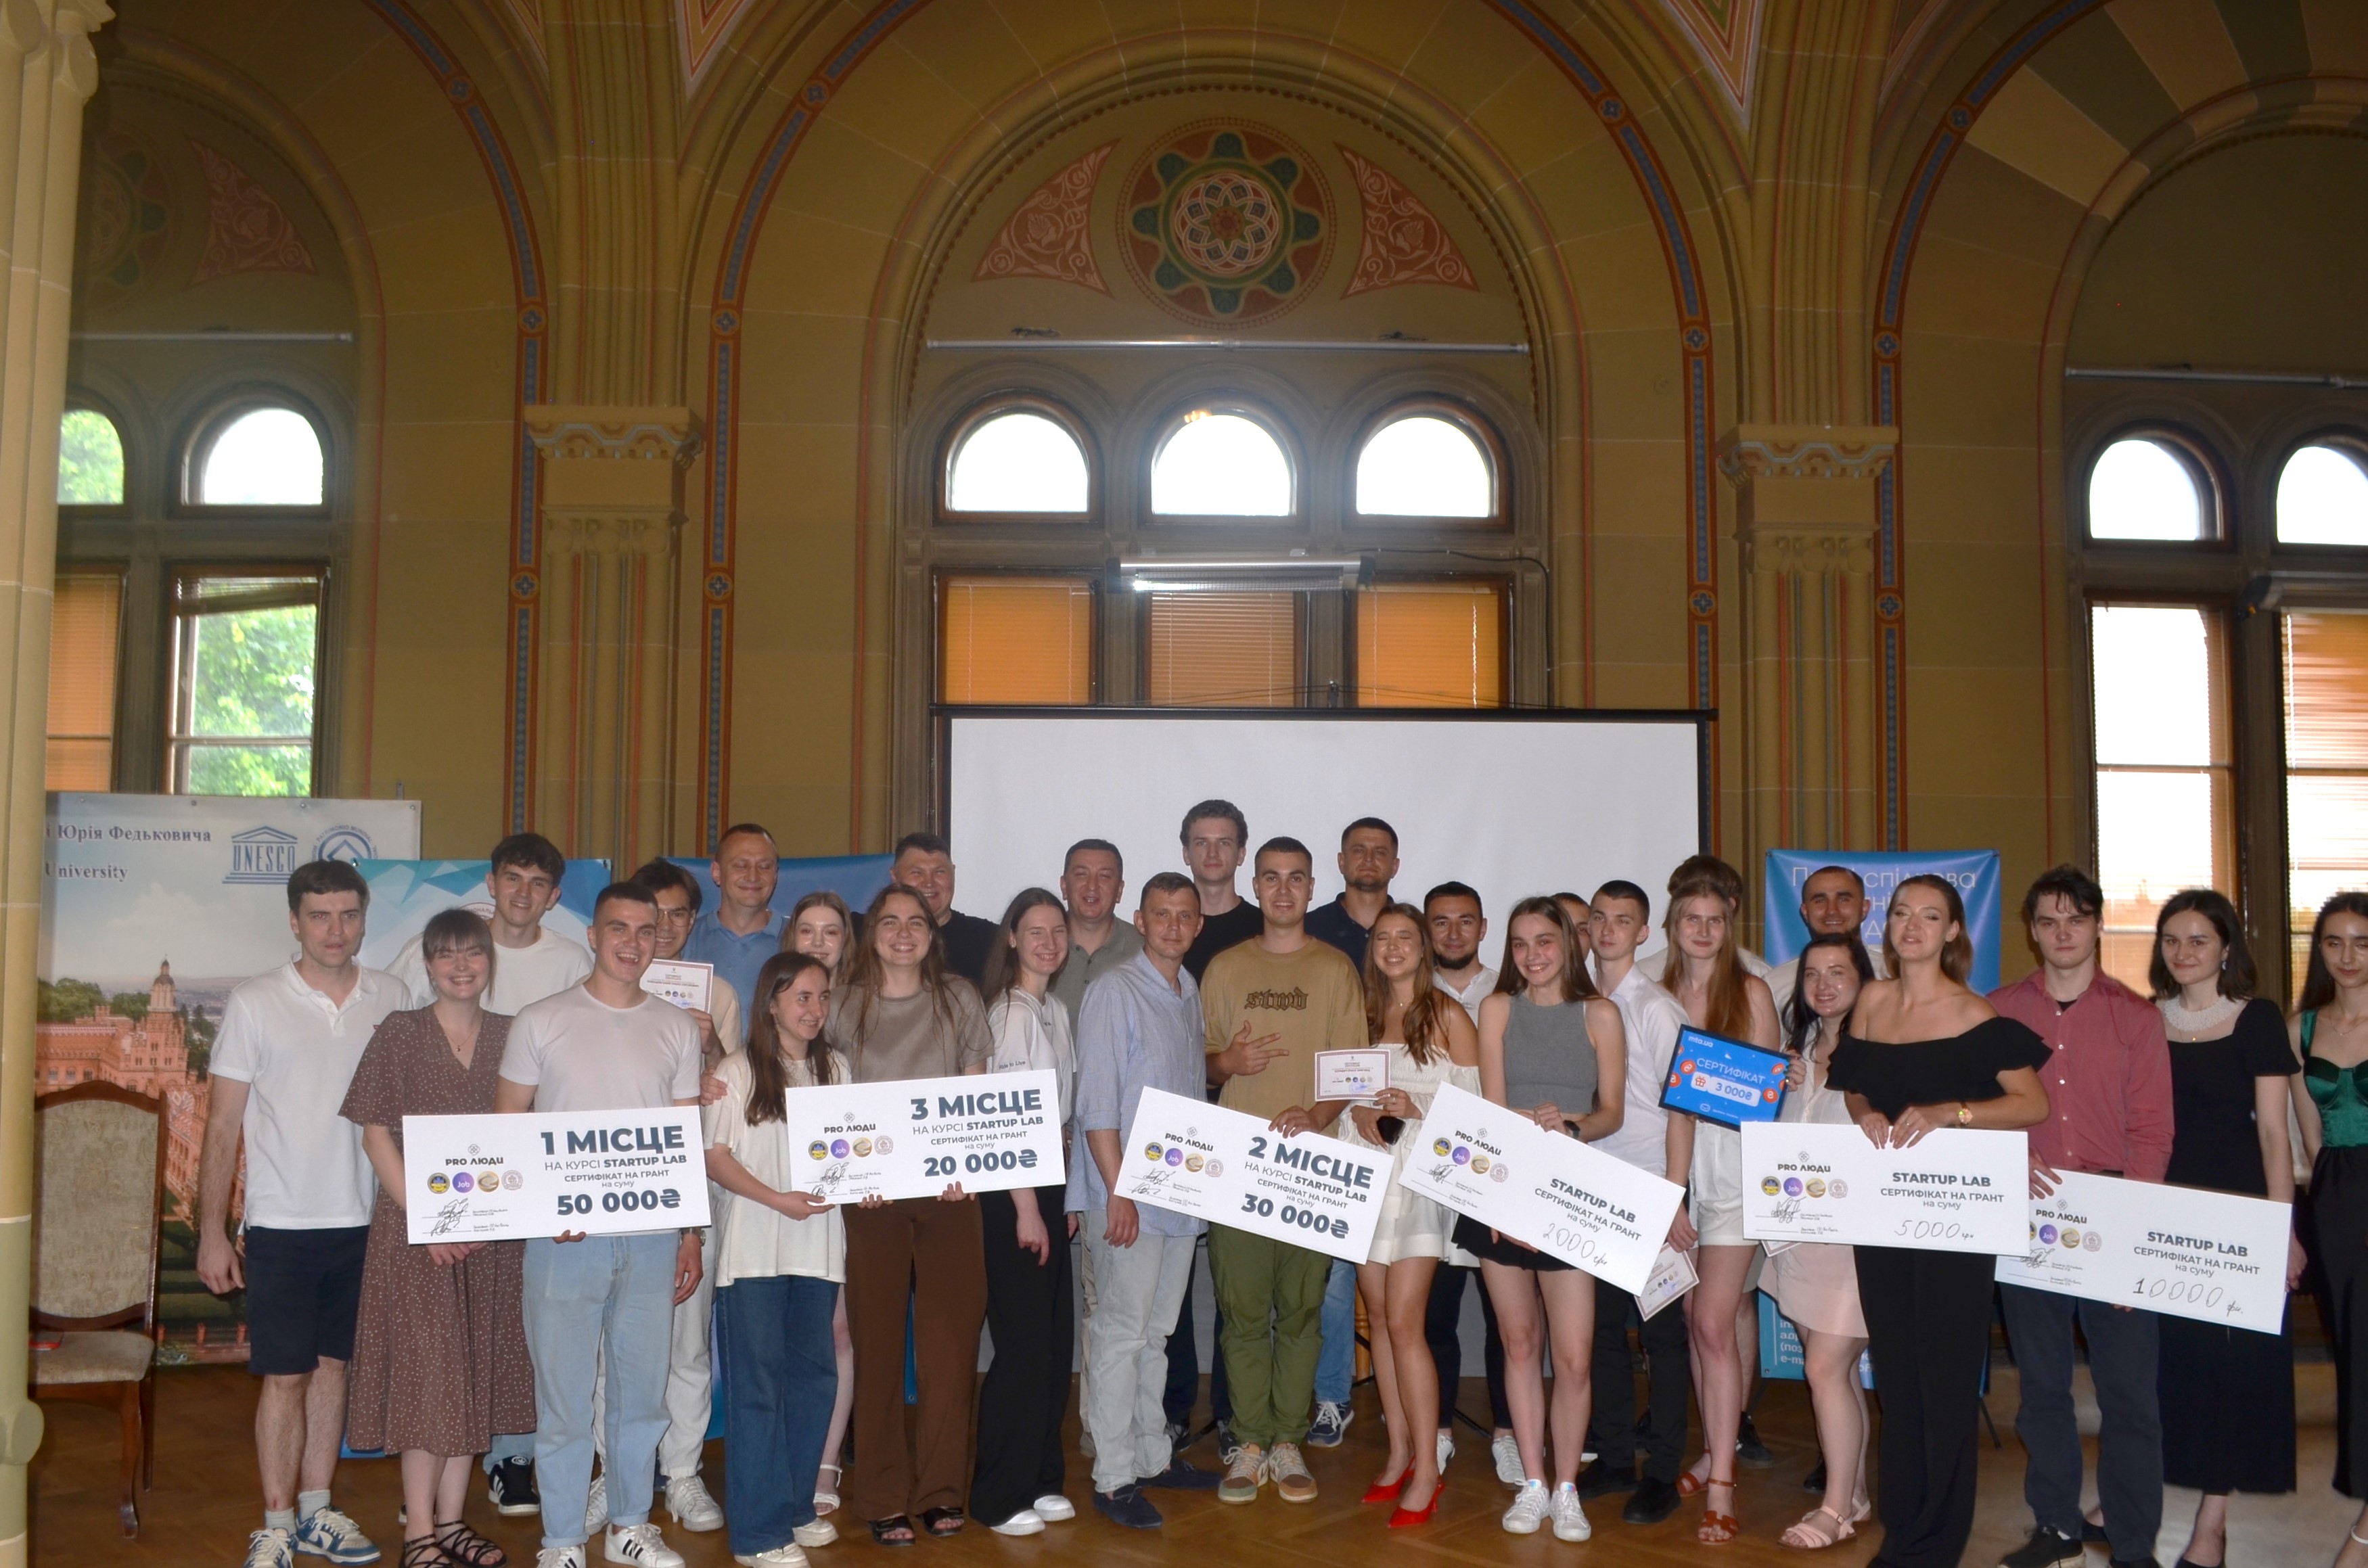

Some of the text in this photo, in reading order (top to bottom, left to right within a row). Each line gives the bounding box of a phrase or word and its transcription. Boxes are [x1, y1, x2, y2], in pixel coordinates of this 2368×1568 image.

[58, 825, 102, 842] Юрія
[109, 826, 211, 841] Федьковича
[233, 845, 296, 872] UNESCO
[45, 863, 128, 882] University
[1697, 1058, 1766, 1084] СЕРТИФІКАТ
[1716, 1083, 1723, 1091] 3
[911, 1089, 1042, 1120] 3 МІСЦЕ
[824, 1126, 843, 1134] PRO
[913, 1117, 1043, 1135] НА КУРСІ STARTUP LAB
[541, 1126, 685, 1155] 1 МІСЦЕ
[931, 1134, 984, 1145] СЕРТИФІКАТ
[1000, 1131, 1027, 1139] ГРАНТ
[1165, 1133, 1183, 1143] PRO
[1455, 1130, 1473, 1143] PRO
[545, 1155, 687, 1171] НА КУРСІ STARTUP LAB
[924, 1156, 957, 1177] 20
[1248, 1136, 1374, 1189] 2 МІСЦЕ
[1455, 1153, 1465, 1161] Job
[564, 1172, 622, 1182] СЕРТИФІКАТ
[641, 1170, 670, 1178] ГРАНТ
[1245, 1161, 1367, 1203] НА КУРСІ STARTUP LAB
[1892, 1172, 1991, 1187] STARTUP LAB
[1258, 1178, 1348, 1209] СЕРТИФІКАТ НА ГРАНТ
[1297, 1198, 1315, 1207] суму
[1550, 1178, 1636, 1223] STARTUP LAB
[1881, 1188, 2004, 1203] СЕРТИФІКАТ НА ГРАНТ
[557, 1194, 593, 1216] 50
[1241, 1193, 1274, 1217] 30
[1535, 1188, 1642, 1241] СЕРТИФІКАТ НА ГРАНТ
[1938, 1201, 1961, 1210] суму
[2036, 1209, 2055, 1218] PRO
[1567, 1213, 1601, 1232] на суму
[1894, 1220, 1960, 1239] 5000
[1543, 1223, 1595, 1258] 2000
[2147, 1231, 2248, 1257] STARTUP LAB
[2134, 1246, 2260, 1274] СЕРТИФІКАТ НА ГРАНТ
[2176, 1264, 2214, 1278] на суму
[2133, 1278, 2223, 1308] 10000
